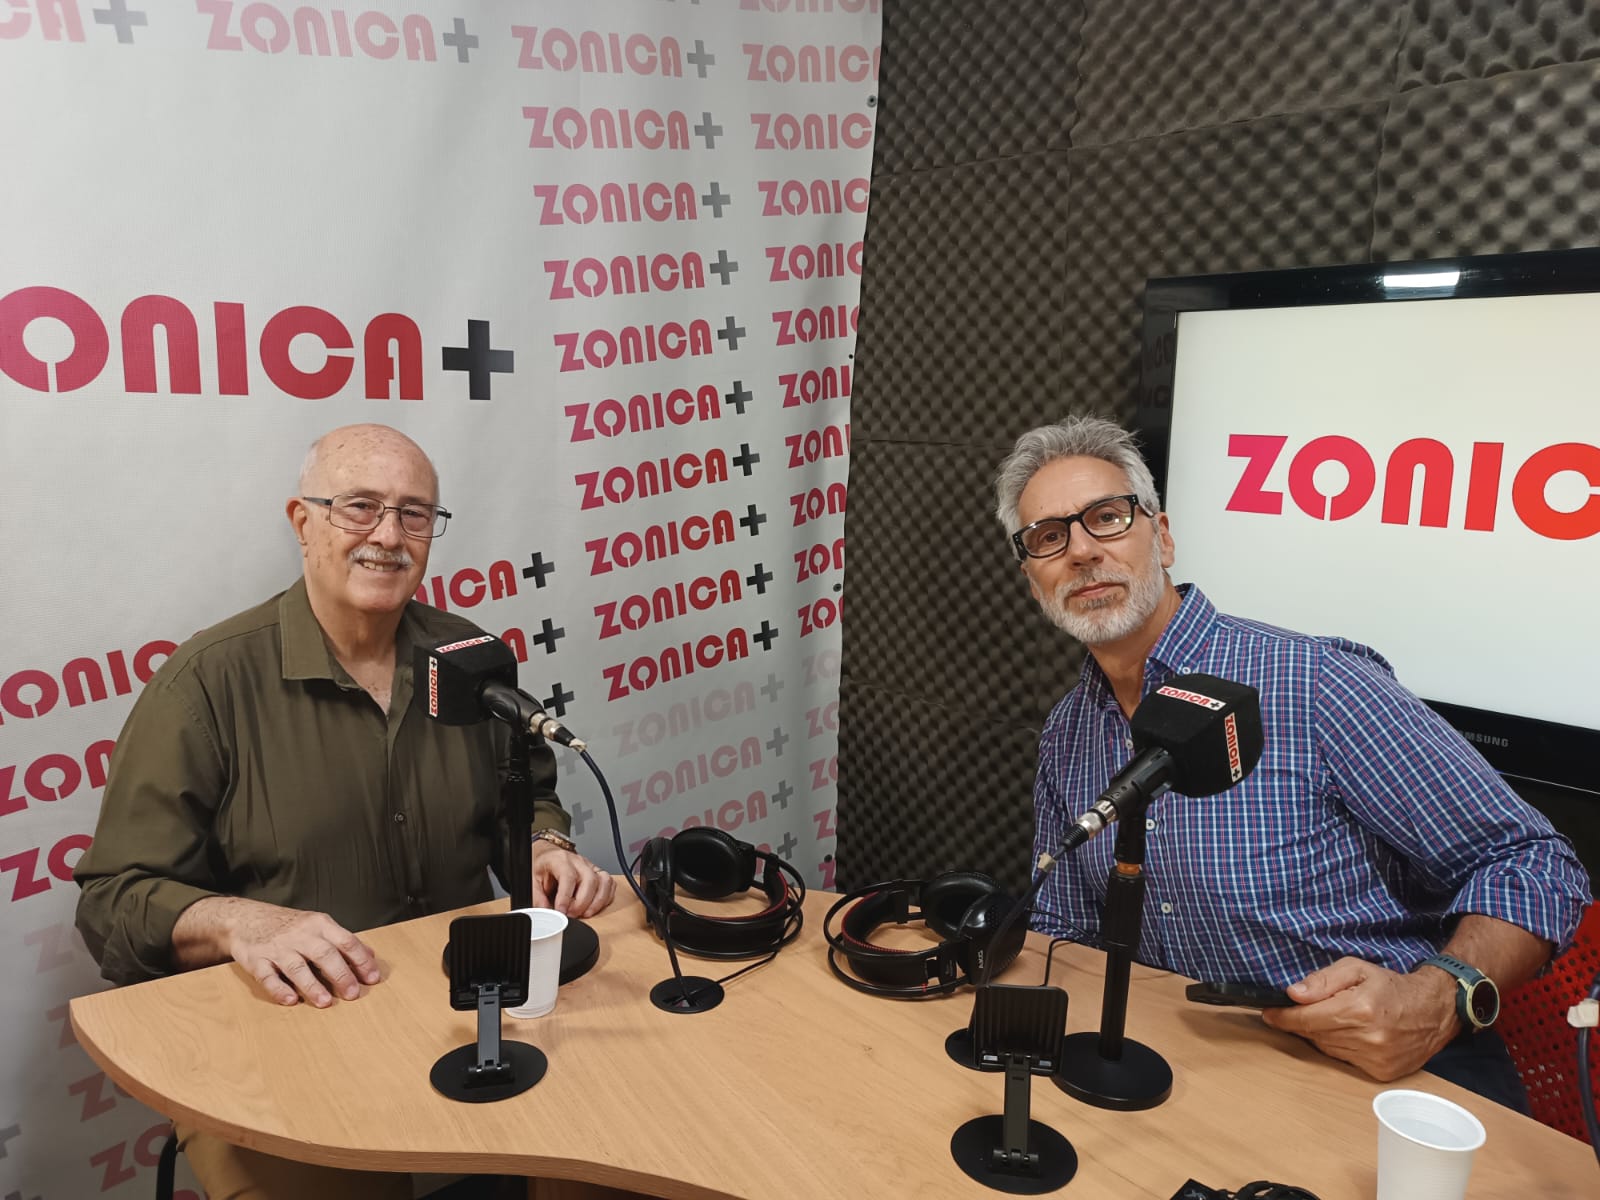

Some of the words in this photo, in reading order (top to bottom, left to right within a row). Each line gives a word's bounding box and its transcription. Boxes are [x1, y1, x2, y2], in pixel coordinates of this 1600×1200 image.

[511, 25, 715, 78] ZONICA+
[522, 106, 723, 150] ZONICA+
[533, 182, 731, 226] ZONICA+
[543, 250, 739, 300] ZONICA+
[553, 316, 746, 373] ZONICA+
[564, 380, 753, 443] ZONICA+
[574, 443, 760, 511] ZONICA+
[584, 504, 767, 577] ZONICA+
[593, 563, 773, 640] ZONICA+
[602, 620, 779, 702] ZONICA+
